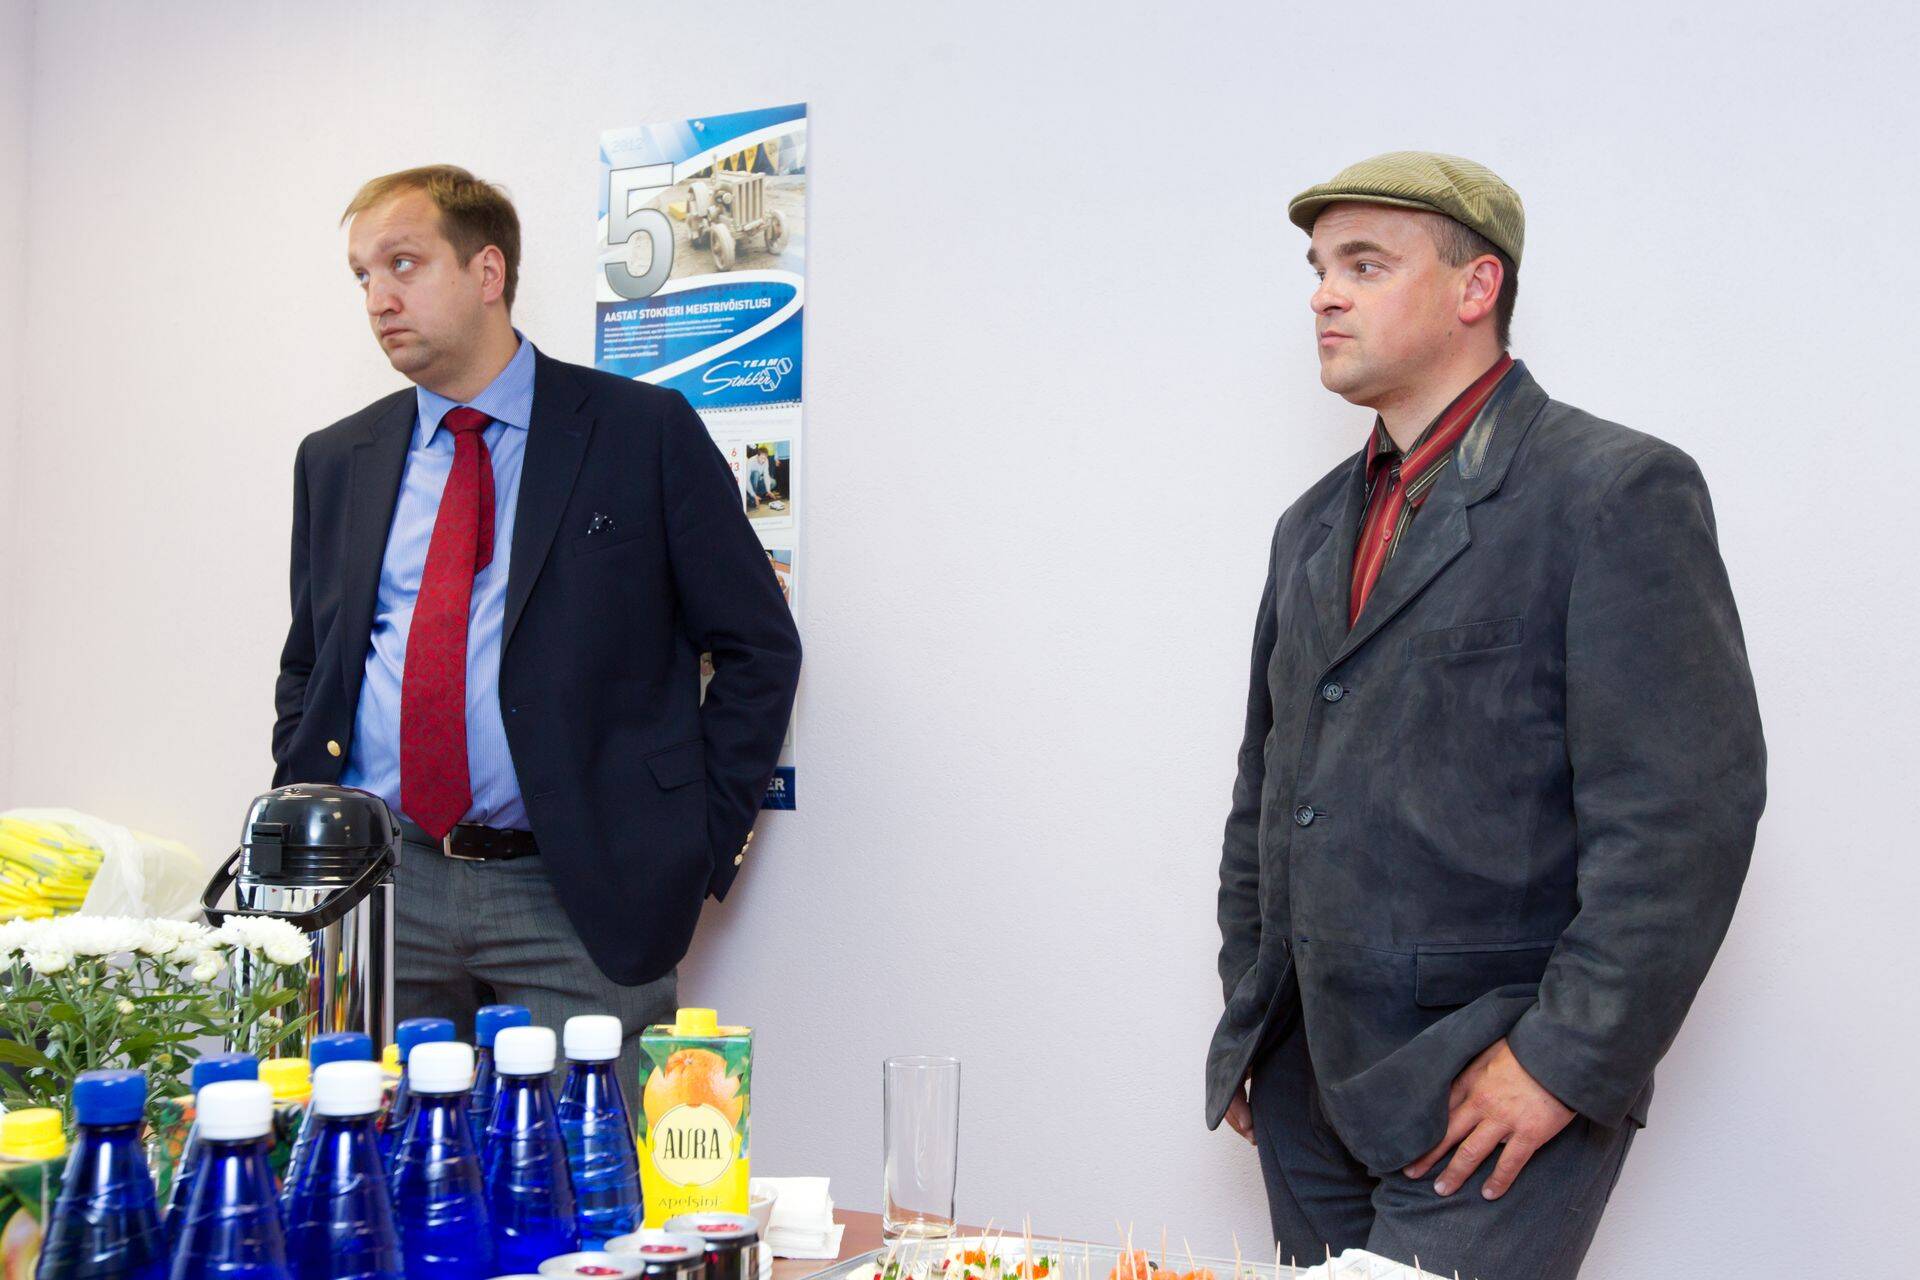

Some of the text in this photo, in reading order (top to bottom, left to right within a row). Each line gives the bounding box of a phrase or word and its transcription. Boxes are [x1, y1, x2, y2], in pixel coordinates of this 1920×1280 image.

[605, 162, 675, 300] 5
[604, 298, 772, 322] AASTAT STOKKERI MEISTRIVÕISTLUSI
[743, 358, 779, 368] TEAM
[702, 361, 772, 396] Stokker
[731, 448, 737, 457] 6
[663, 1127, 723, 1160] AURA
